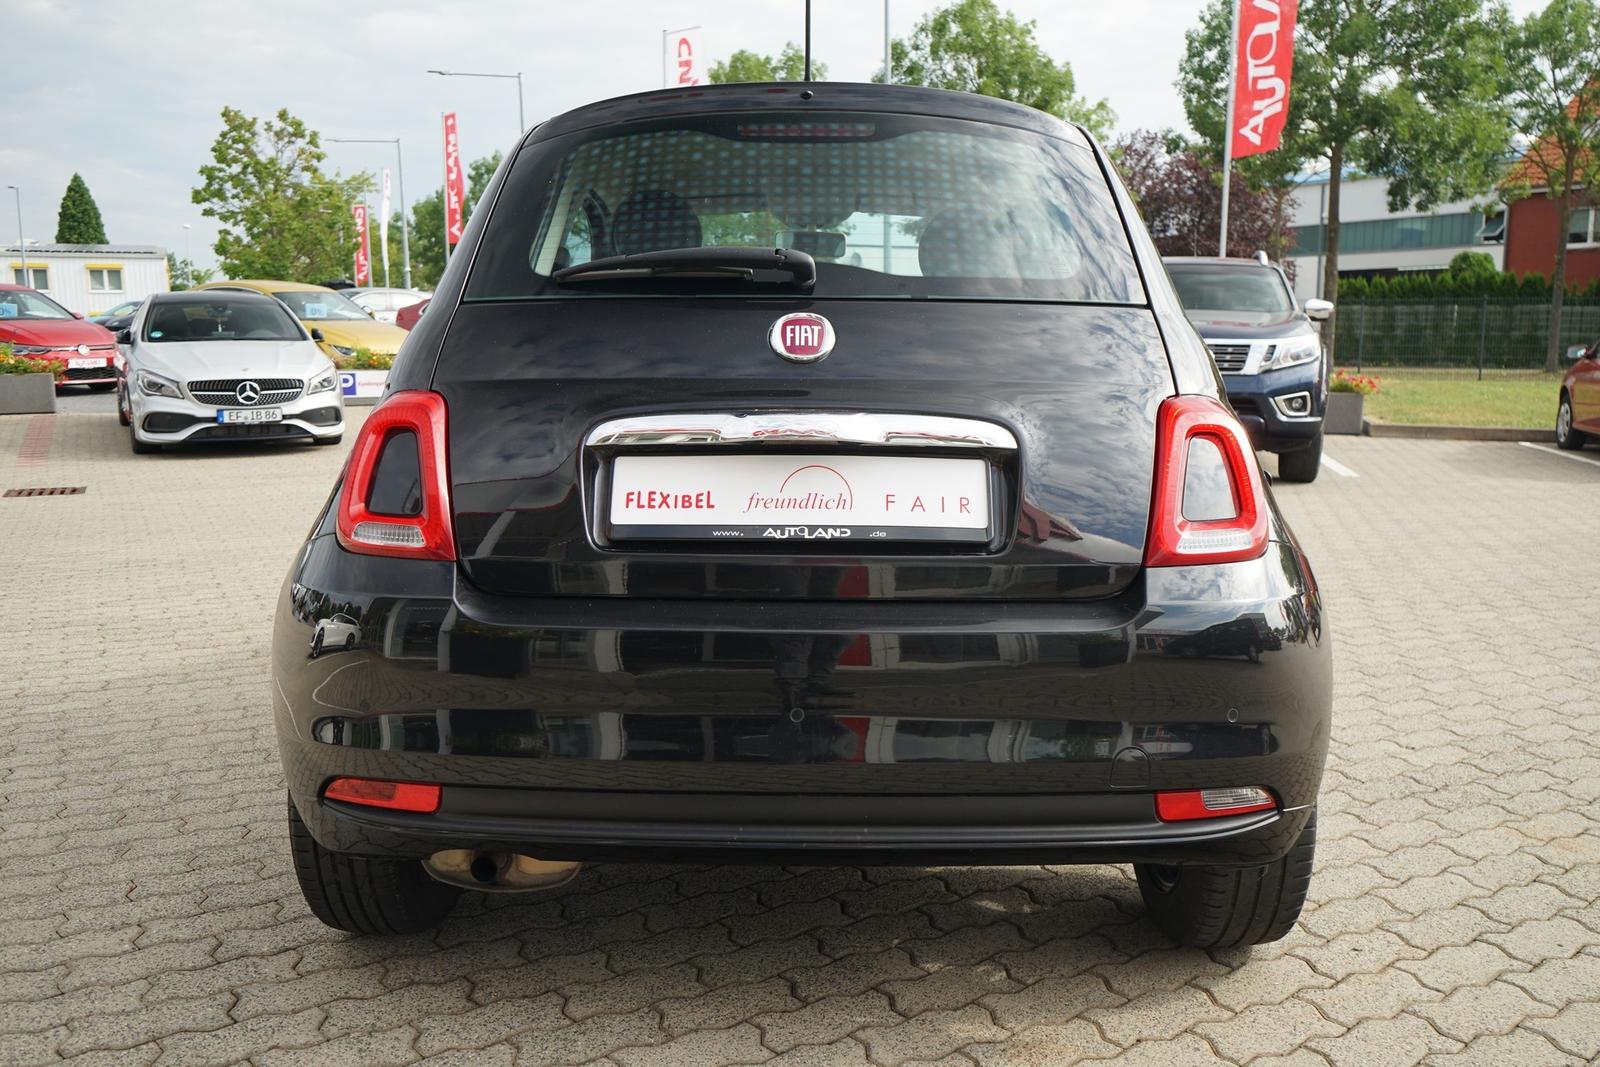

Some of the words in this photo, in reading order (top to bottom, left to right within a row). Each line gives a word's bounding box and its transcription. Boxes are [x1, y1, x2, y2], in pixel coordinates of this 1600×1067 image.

[785, 325, 822, 347] FIAT
[229, 411, 242, 421] EF
[625, 491, 715, 509] FLEXIBEL
[743, 492, 847, 513] freundlich
[885, 494, 971, 514] FAIR
[763, 526, 851, 539] AUTOLAND
